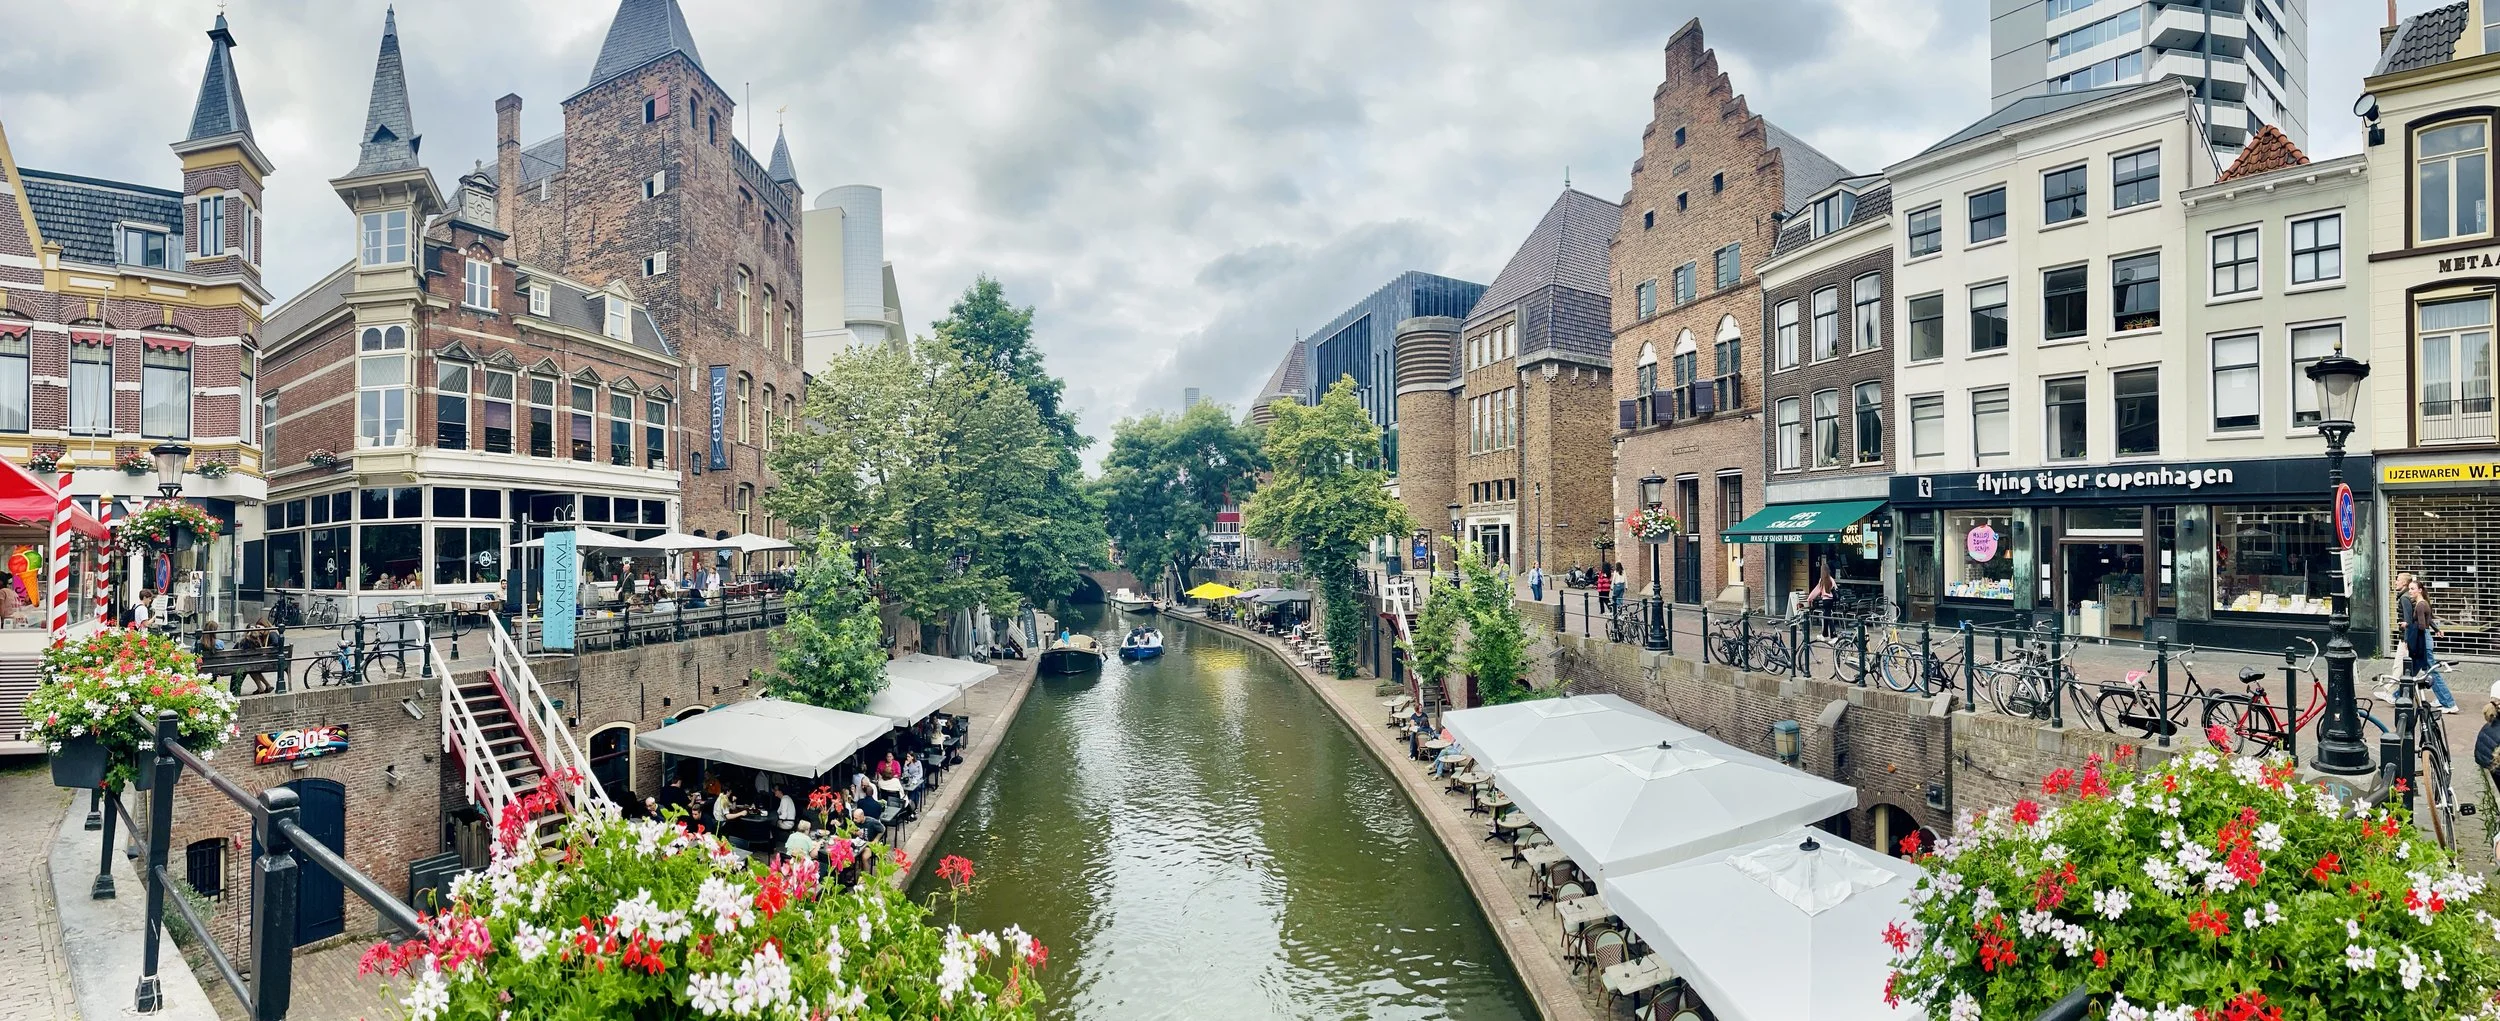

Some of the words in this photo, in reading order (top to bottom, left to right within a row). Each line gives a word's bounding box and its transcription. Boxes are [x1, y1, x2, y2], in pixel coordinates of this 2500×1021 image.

[2389, 468, 2460, 479] IJZERWAREN
[2468, 465, 2488, 478] W.
[1977, 472, 2031, 495] flying
[2035, 470, 2089, 494] tiger
[2095, 466, 2233, 491] copenhagen
[1846, 524, 1859, 534] OFF
[1784, 534, 1802, 542] BURGERS
[1842, 534, 1863, 544] SMASH
[555, 540, 568, 617] TAVERNA
[298, 728, 330, 750] 105
